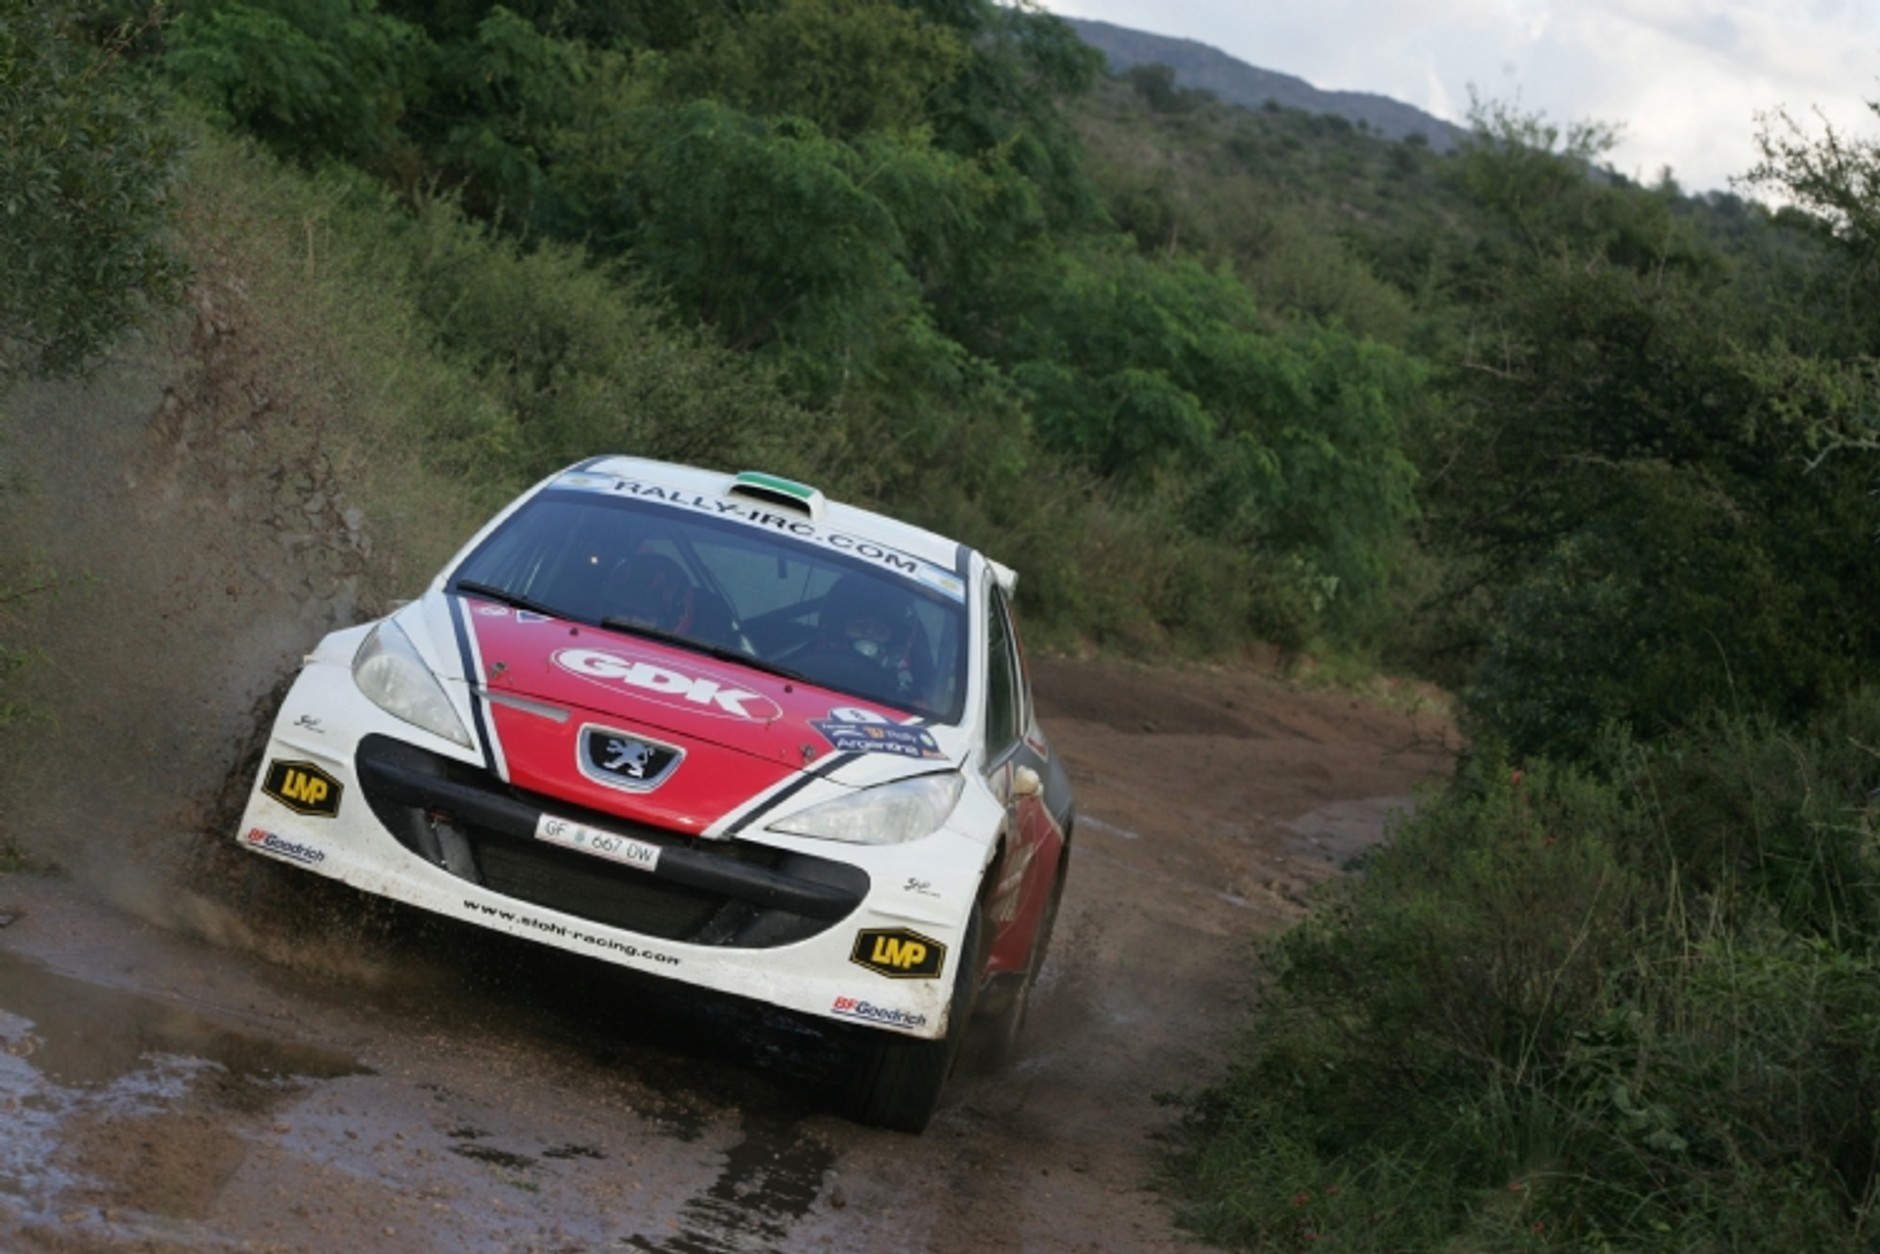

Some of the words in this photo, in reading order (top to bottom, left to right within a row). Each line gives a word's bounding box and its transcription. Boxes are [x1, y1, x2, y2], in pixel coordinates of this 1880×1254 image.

[613, 480, 920, 574] RALLY-IRC.COM
[557, 648, 760, 719] GDK
[281, 769, 328, 804] LMP
[247, 827, 326, 862] BFGoodrich
[546, 820, 568, 837] GF
[591, 834, 623, 853] 667
[871, 935, 927, 970] LMP
[832, 995, 927, 1027] BFGoodrich
